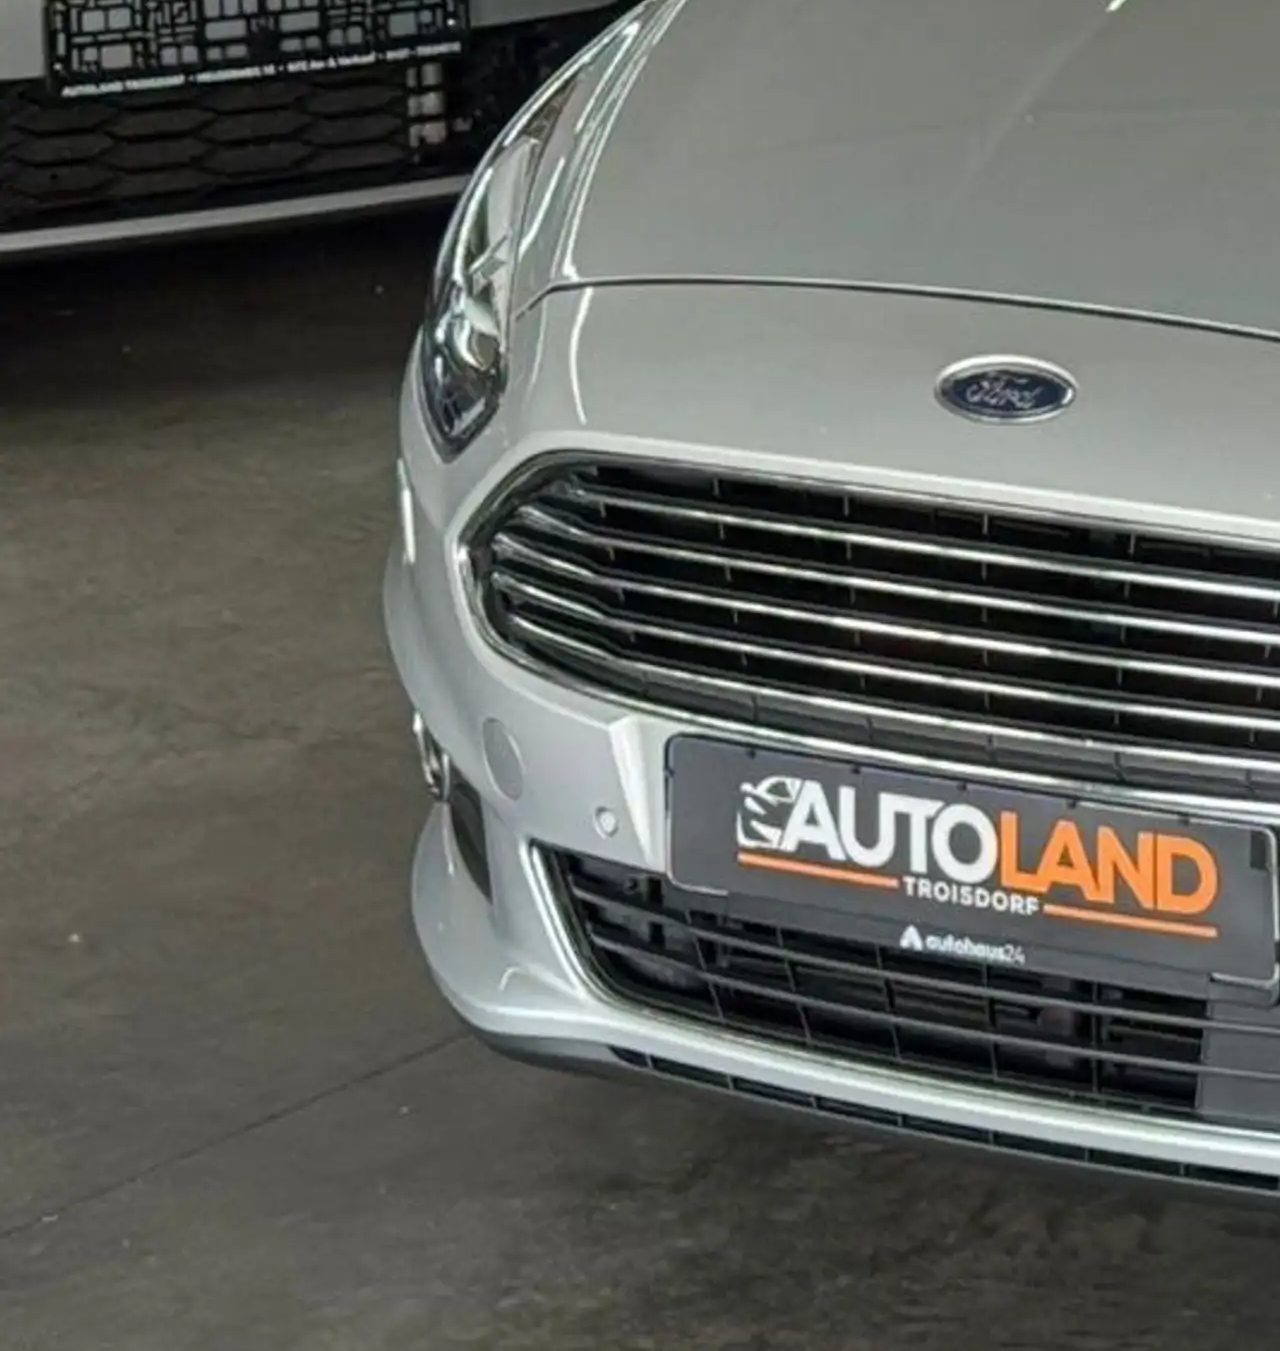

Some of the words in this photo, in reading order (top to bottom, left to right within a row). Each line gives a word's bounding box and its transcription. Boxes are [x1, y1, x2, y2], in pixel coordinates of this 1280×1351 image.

[965, 373, 1044, 410] Ford
[779, 777, 1220, 917] AUTOLAND
[902, 875, 1040, 915] TROISDORF
